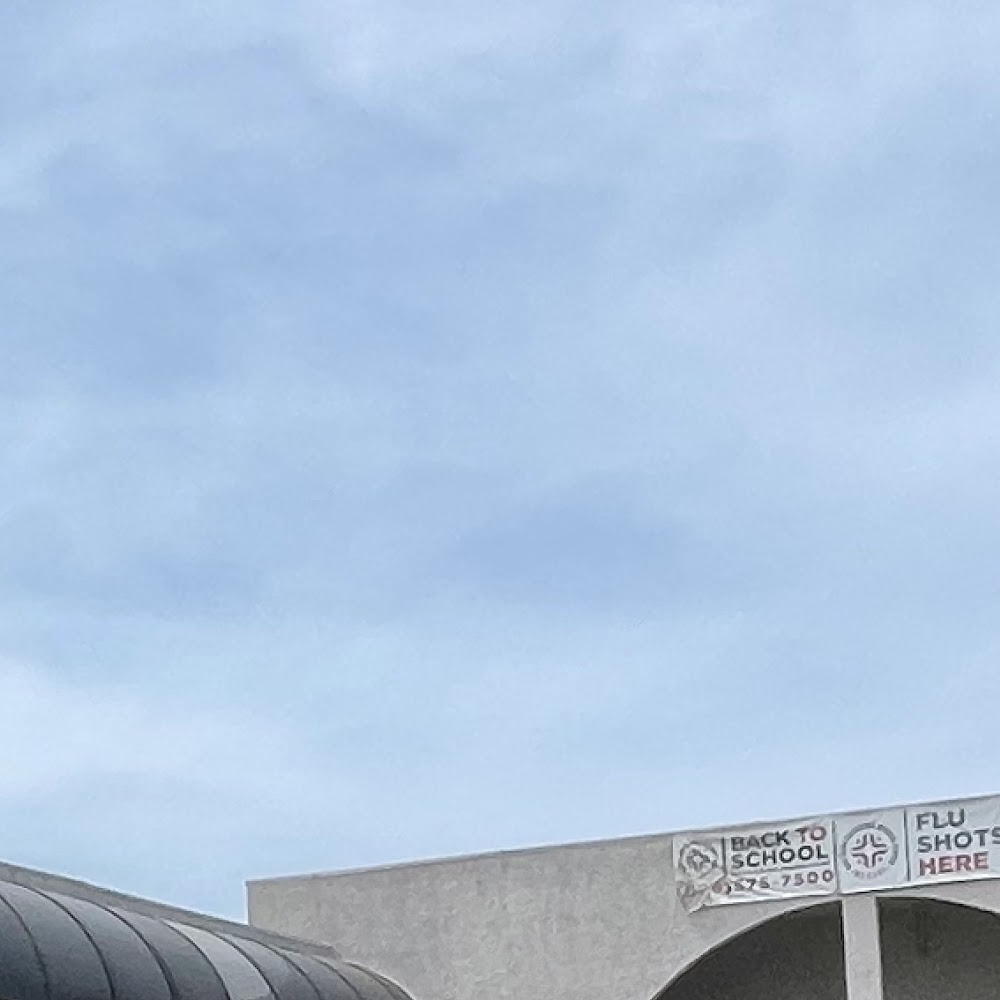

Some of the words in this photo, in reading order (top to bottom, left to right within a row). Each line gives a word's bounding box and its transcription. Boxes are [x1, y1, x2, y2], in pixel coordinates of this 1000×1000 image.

[916, 808, 965, 830] FLU
[730, 829, 790, 851] BACK
[795, 825, 827, 843] TO
[730, 845, 829, 869] SCHOOL
[919, 851, 989, 875] HERE
